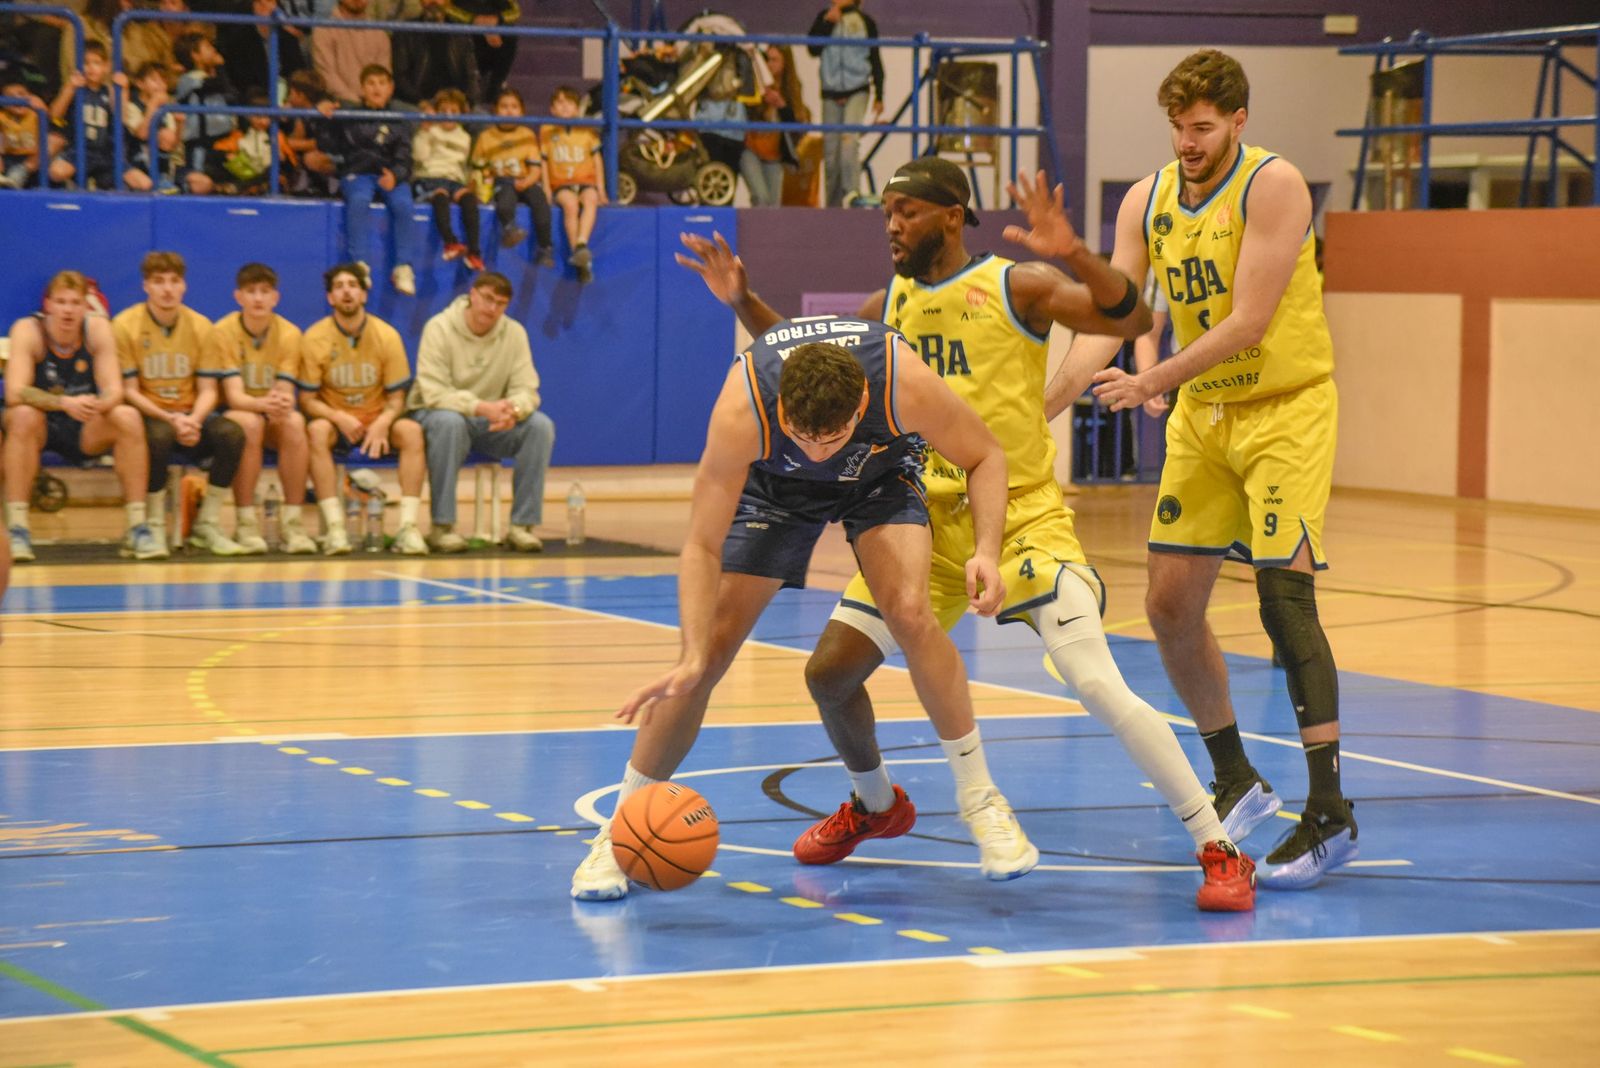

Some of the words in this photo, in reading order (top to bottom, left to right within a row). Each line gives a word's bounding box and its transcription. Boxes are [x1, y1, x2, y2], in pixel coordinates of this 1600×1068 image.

[1166, 256, 1228, 305] CBA
[922, 306, 942, 316] vive
[764, 322, 828, 346] STROG
[143, 353, 191, 379] ULB
[330, 362, 377, 388] ULB
[1263, 496, 1283, 505] vive
[1263, 512, 1278, 537] 9
[1018, 558, 1036, 580] 4
